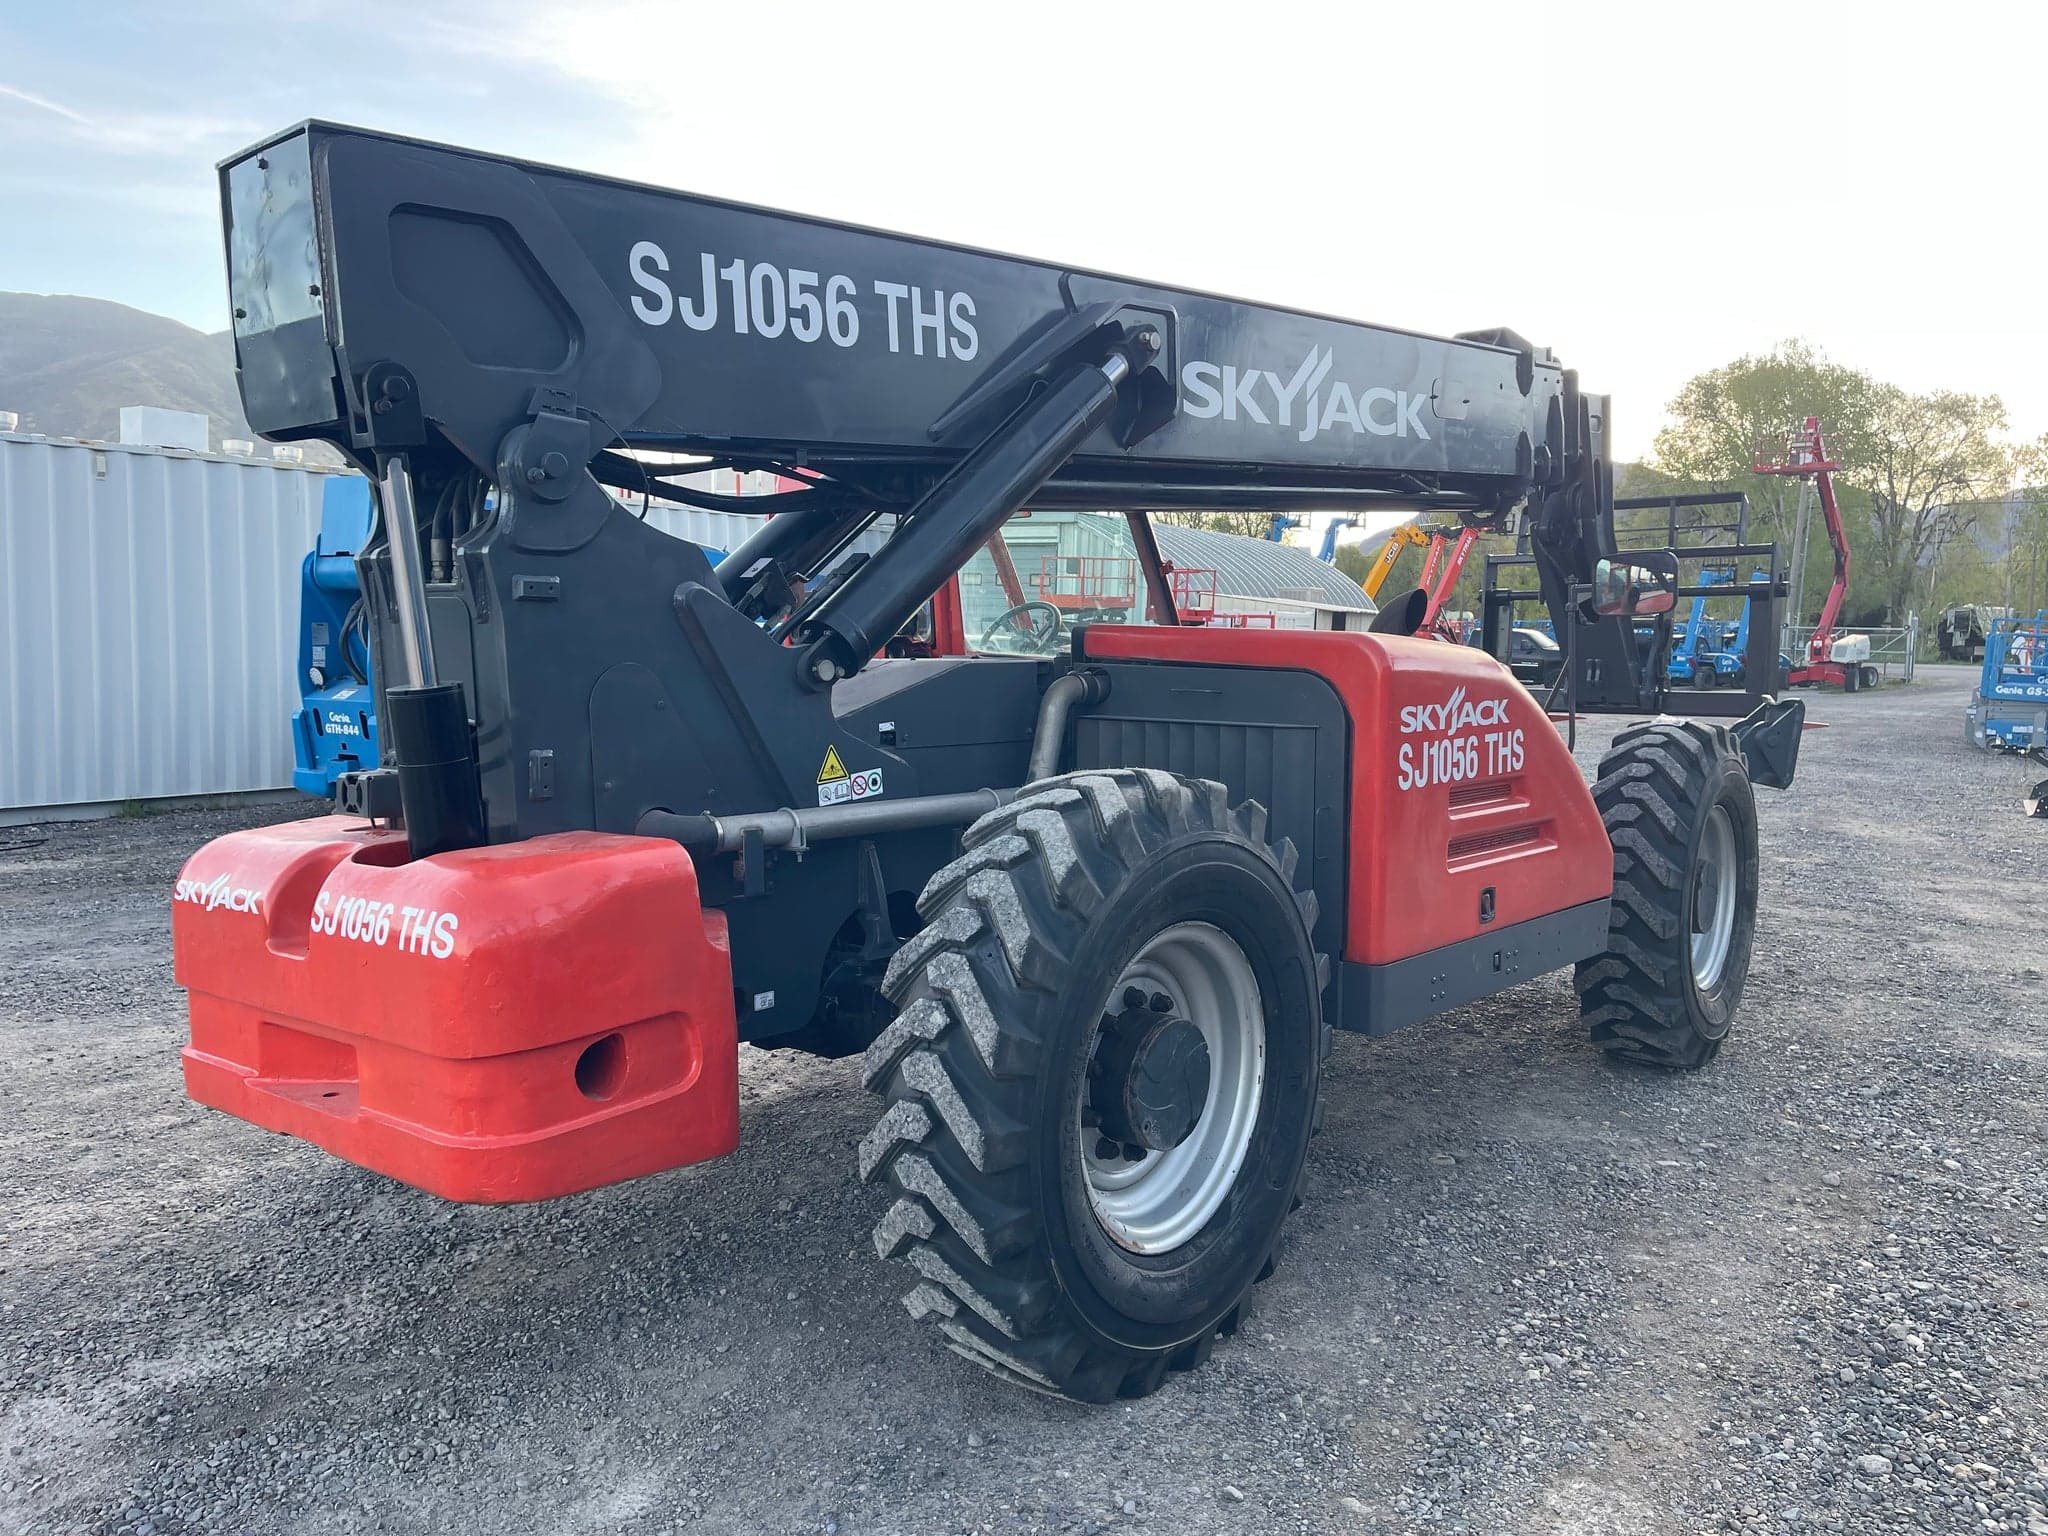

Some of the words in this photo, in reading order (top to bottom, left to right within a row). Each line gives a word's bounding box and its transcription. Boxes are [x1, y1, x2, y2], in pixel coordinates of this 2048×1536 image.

[629, 240, 860, 348] SJ1056
[873, 279, 979, 362] THS
[1181, 343, 1432, 442] SKYJACK
[1385, 541, 1400, 564] JCB
[1400, 686, 1510, 736] SKYJACK
[1995, 685, 2023, 695] Genie
[325, 723, 360, 736] GTH-844
[1398, 735, 1479, 791] SJ1056
[1484, 728, 1524, 776] THS
[174, 872, 262, 915] SKYJACK
[310, 891, 392, 946] SJ1056
[398, 906, 458, 959] THS
